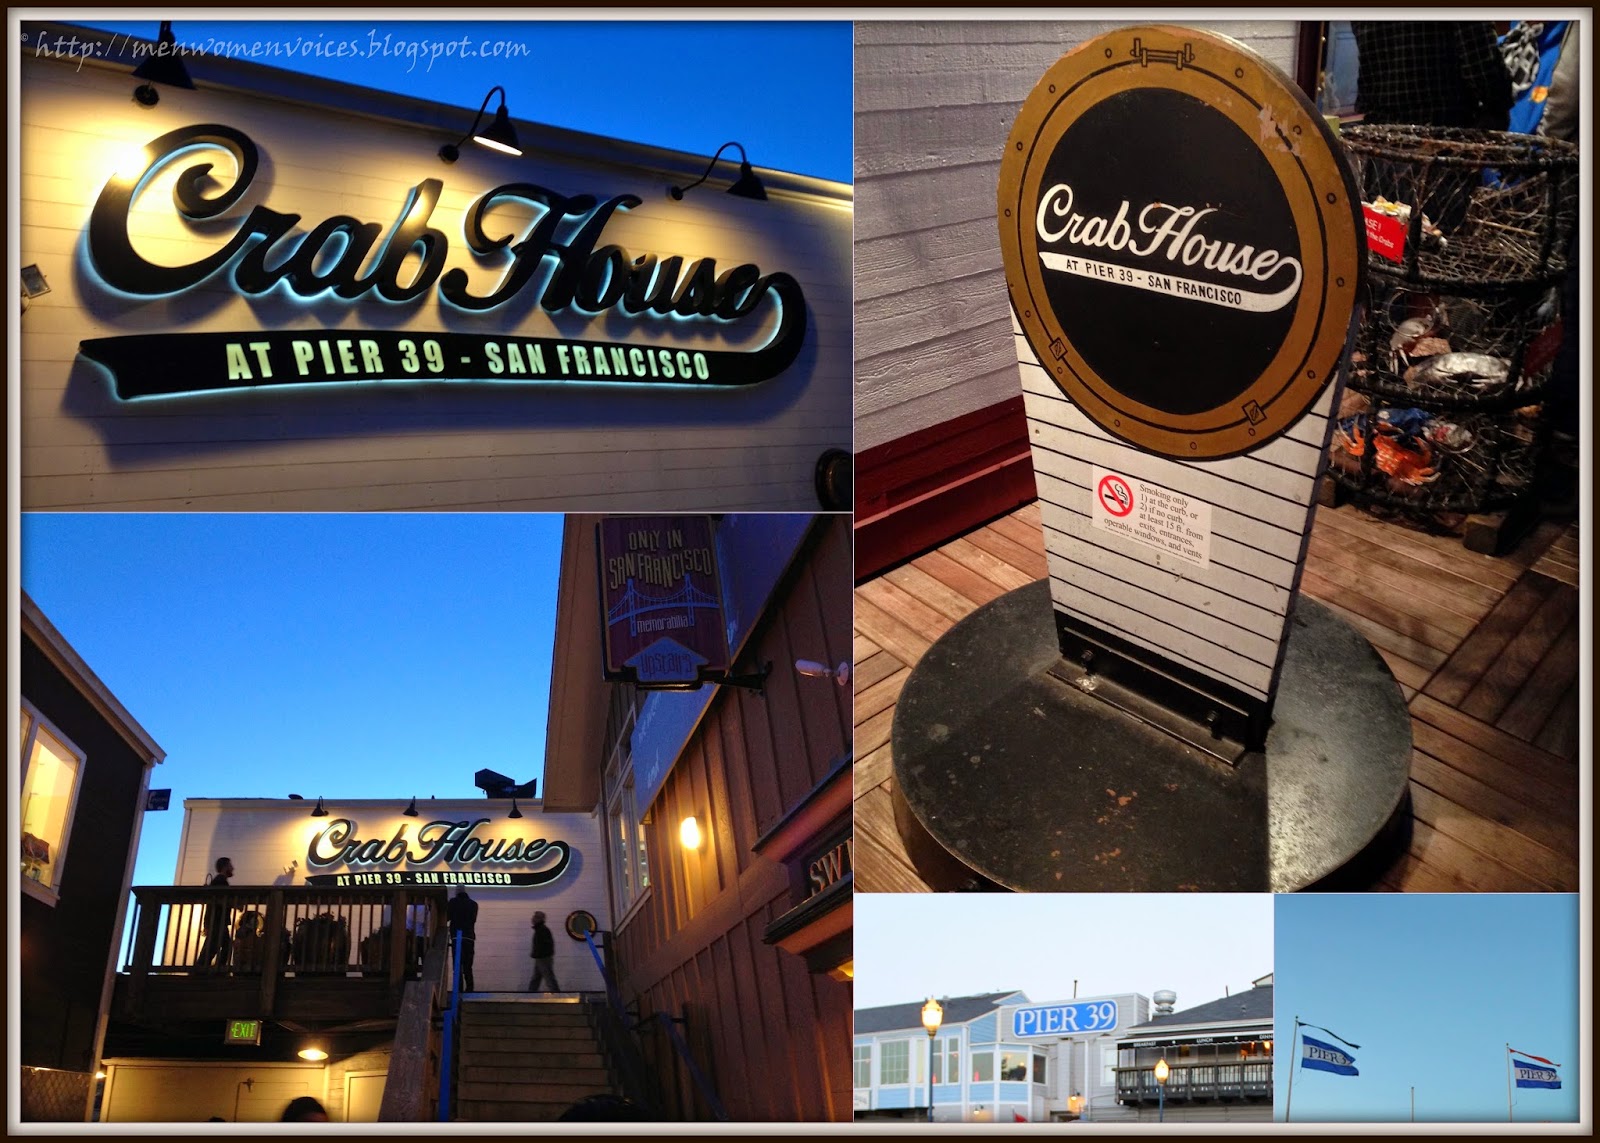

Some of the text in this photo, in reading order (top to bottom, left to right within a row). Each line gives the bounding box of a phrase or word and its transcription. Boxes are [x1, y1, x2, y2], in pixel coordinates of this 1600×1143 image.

[89, 124, 772, 321] Crab House
[1036, 183, 1280, 282] Crab House
[1066, 258, 1079, 271] AT
[1085, 262, 1115, 282] PIER
[1119, 268, 1134, 283] 39
[1147, 275, 1171, 292] SAN
[1176, 281, 1242, 306] FRANCISCO
[225, 341, 273, 380] AT
[292, 339, 385, 376] PIER
[398, 339, 445, 374] 39
[484, 341, 547, 374] SAN
[556, 344, 710, 380] FRANCISCO
[1140, 483, 1189, 509] Smoking only
[1149, 497, 1156, 505] at
[1157, 499, 1169, 509] the
[1190, 512, 1198, 520] or
[1149, 506, 1155, 515] if
[1156, 510, 1166, 518] no
[628, 529, 682, 552] ONLY IN
[1104, 518, 1132, 533] operable
[1168, 540, 1181, 552] and
[1183, 547, 1202, 559] vents
[1140, 513, 1146, 521] at
[1147, 514, 1164, 527] least
[1166, 520, 1175, 530] 15
[1186, 528, 1204, 541] from
[609, 548, 713, 590] SAN FRANCISCO
[637, 615, 689, 634] memorabilia
[308, 818, 550, 866] Crab House
[336, 876, 351, 887] AT
[355, 874, 382, 886] PIER
[386, 873, 402, 884] 39
[415, 872, 439, 884] SAN
[443, 872, 512, 885] FRANCISCO
[233, 1022, 256, 1038] EXIT
[1017, 1002, 1115, 1035] PIER 39
[1309, 1046, 1340, 1064] PIER
[1520, 1069, 1557, 1081] PIER 39
